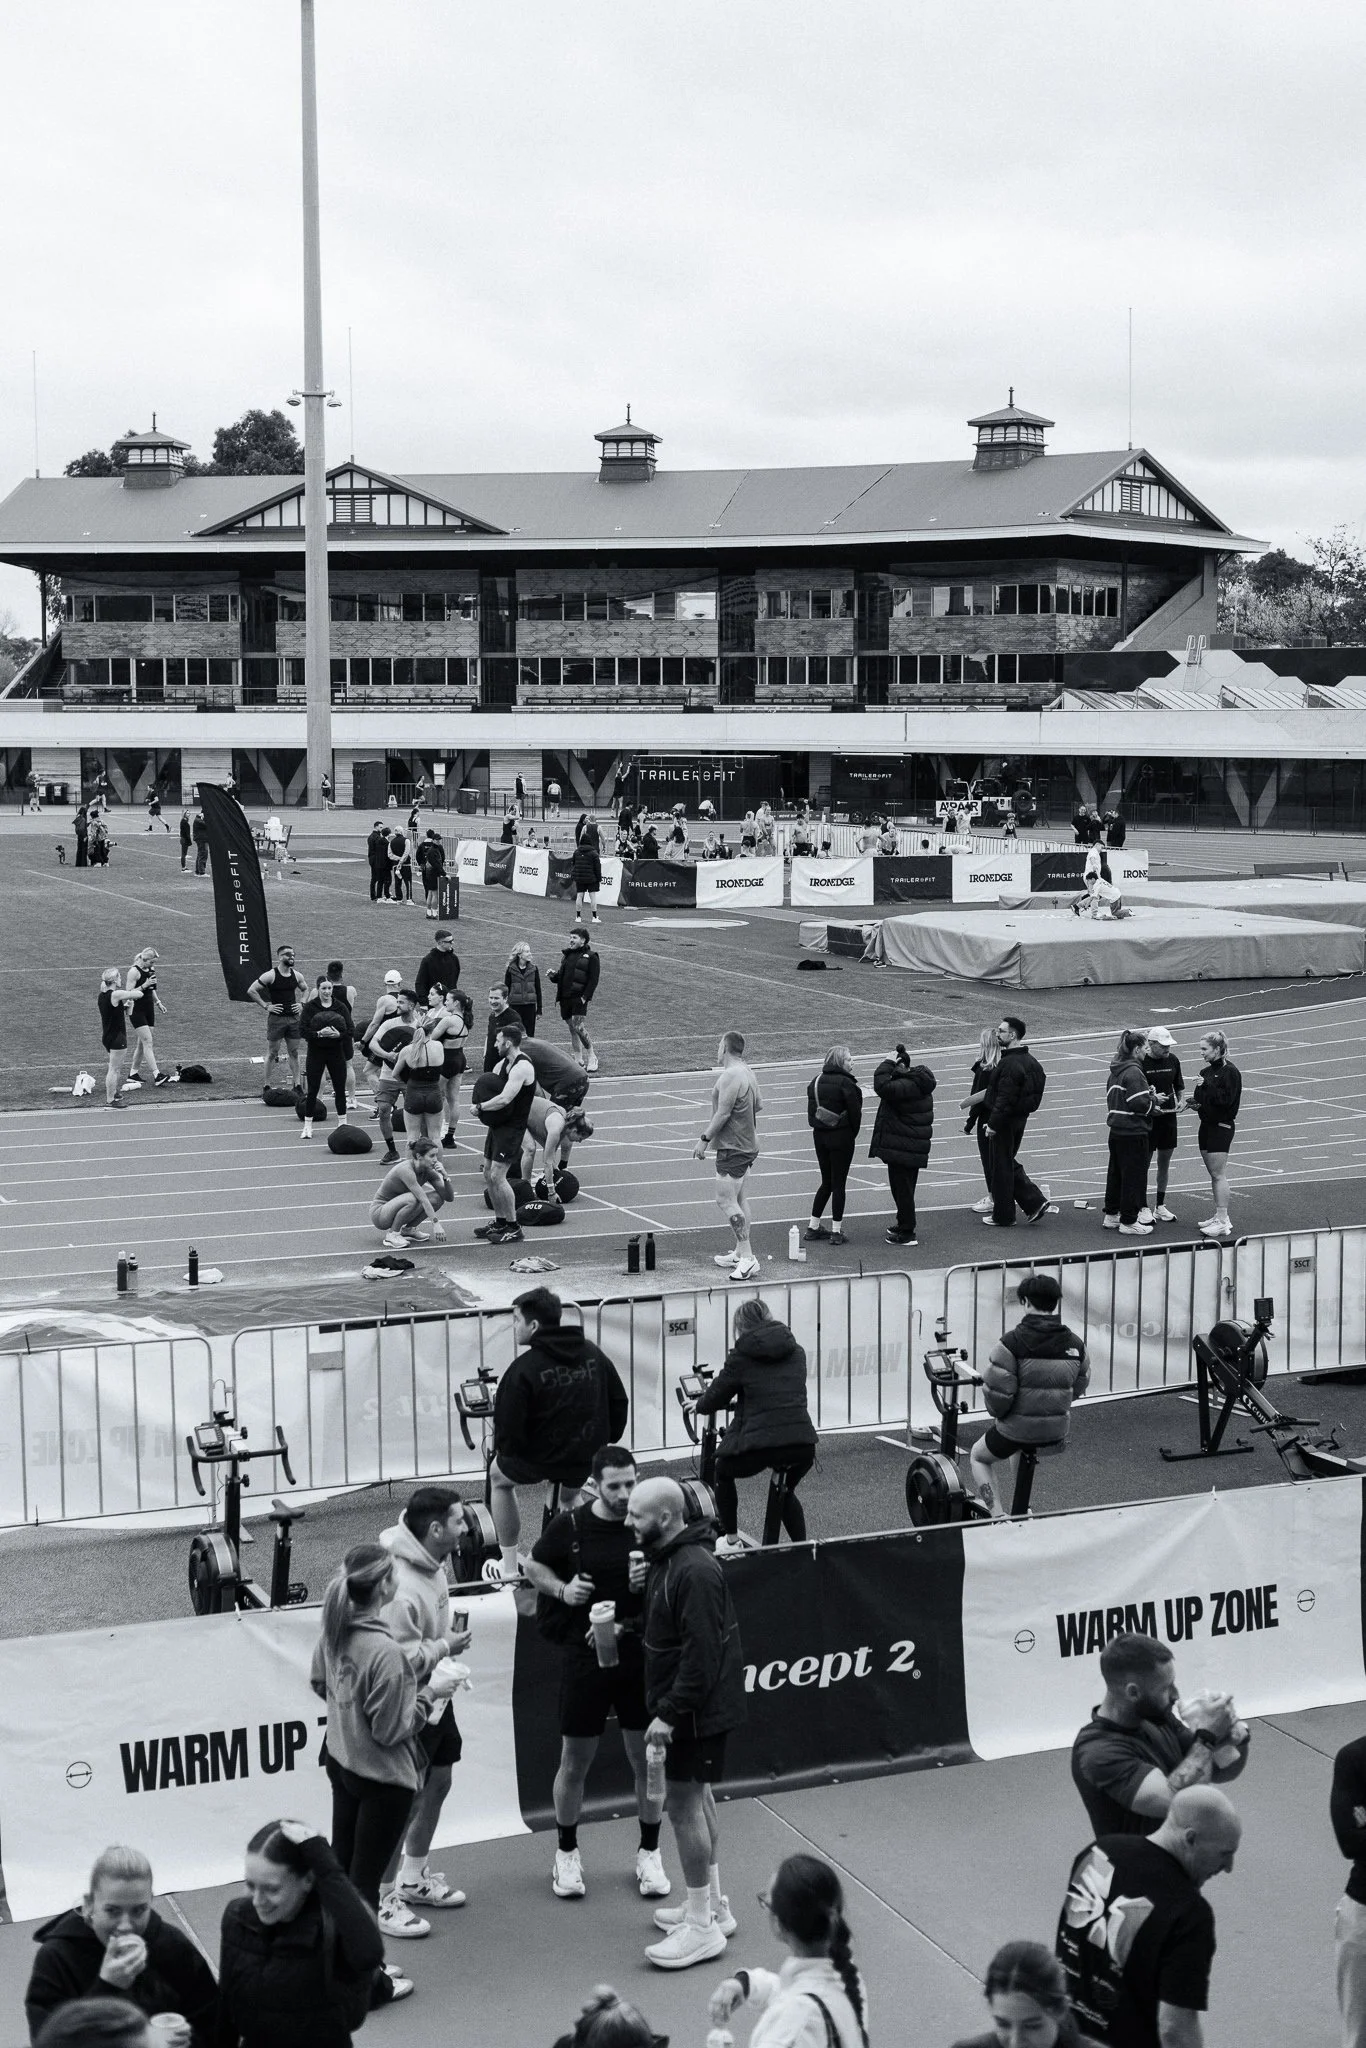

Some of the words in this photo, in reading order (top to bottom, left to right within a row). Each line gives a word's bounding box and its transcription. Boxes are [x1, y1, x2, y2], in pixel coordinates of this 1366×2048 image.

[715, 878, 764, 889] IRONEDGE
[809, 877, 855, 887] IRONEDGE
[969, 873, 1013, 883] IRONEDGE
[1294, 1259, 1311, 1269] SSCT
[669, 1321, 689, 1332] SSCT
[1056, 1601, 1158, 1658] WARM
[1164, 1596, 1203, 1643] UP
[1210, 1584, 1279, 1637] ZONE
[119, 1727, 249, 1794] WARM
[259, 1720, 307, 1774] UP
